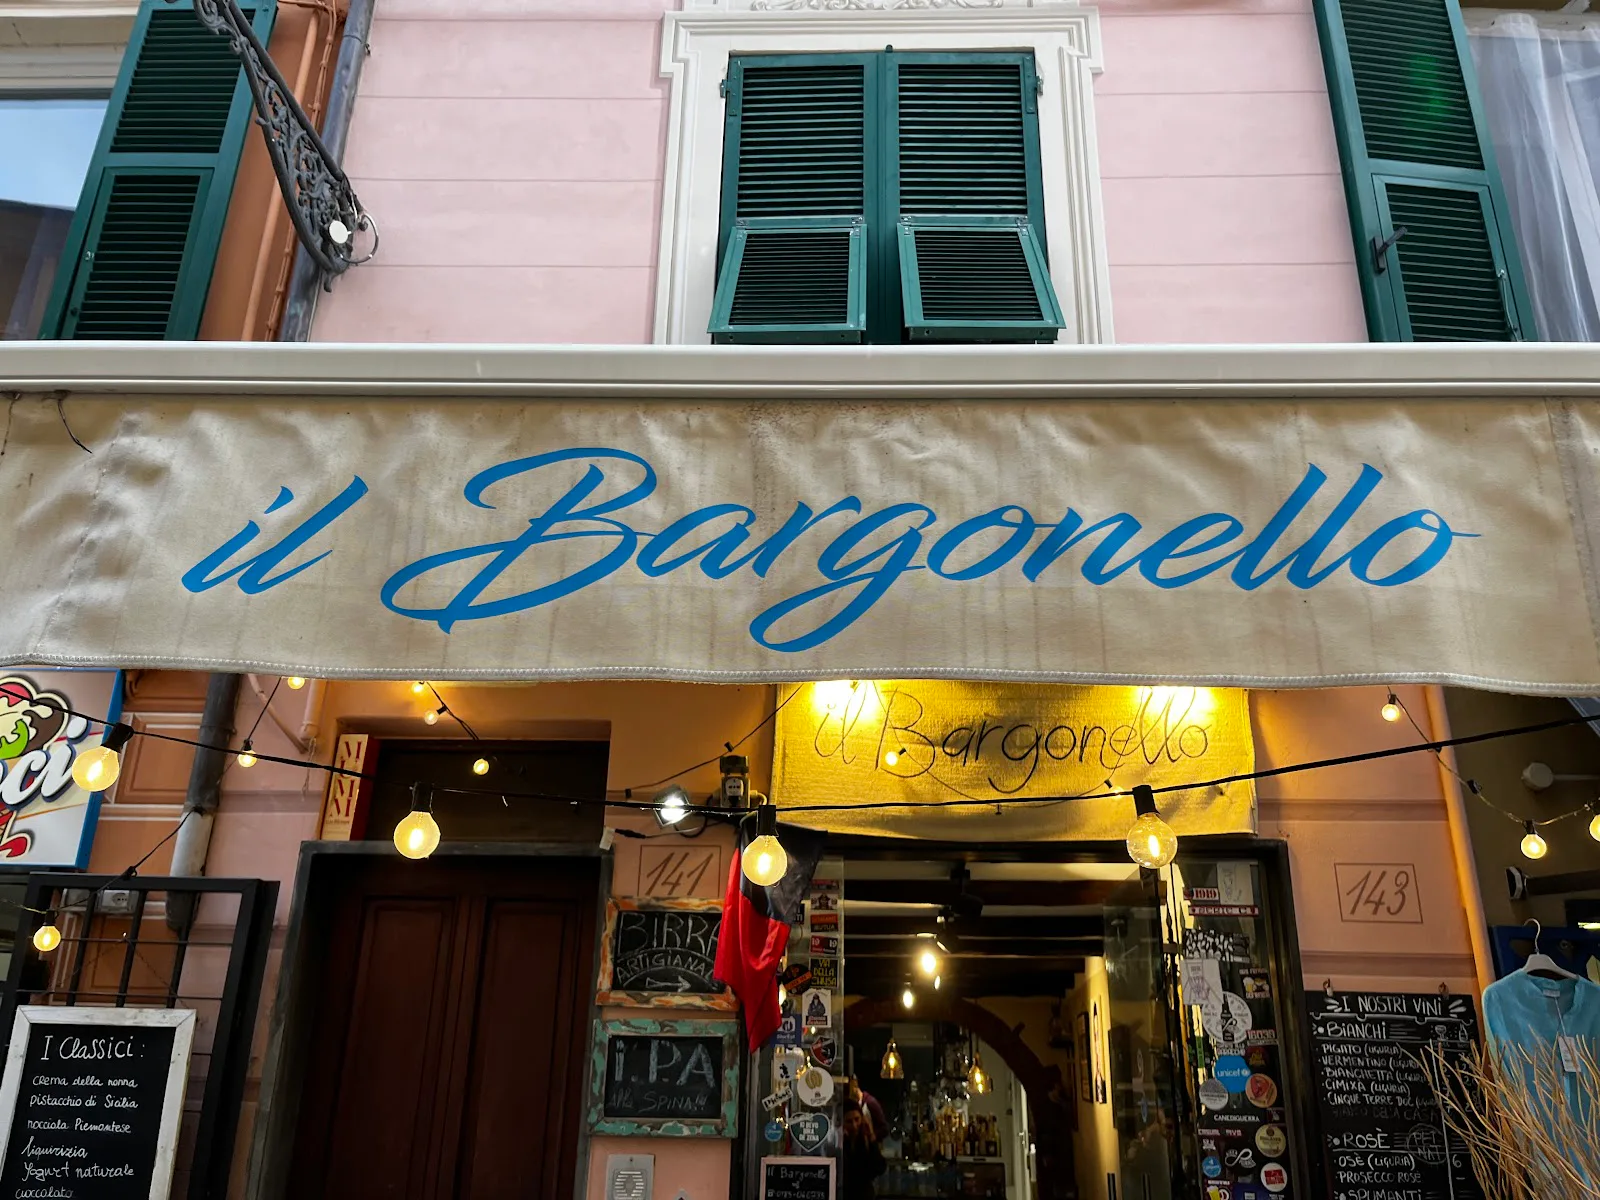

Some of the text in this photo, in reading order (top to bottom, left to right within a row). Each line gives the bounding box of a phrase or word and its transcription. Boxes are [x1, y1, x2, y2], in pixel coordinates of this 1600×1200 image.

[180, 446, 1482, 652] il Bargonello
[875, 686, 1213, 794] Bargonello
[0, 707, 89, 806] ci
[645, 851, 714, 896] 141
[1345, 870, 1410, 916] 143
[813, 967, 834, 977] DELLA
[1341, 996, 1351, 1012] I
[41, 1035, 53, 1060] I
[1322, 1043, 1362, 1055] PIGATO
[1217, 1067, 1240, 1077] unicef
[72, 1076, 103, 1087] della
[107, 1079, 138, 1088] nonna
[85, 1095, 97, 1106] di
[104, 1093, 138, 1108] Sicilia
[1328, 1091, 1361, 1107] CINQUE
[1363, 1094, 1393, 1105] TERRE
[27, 1118, 131, 1133] nocciola Piemontese
[1452, 1154, 1462, 1168] 6
[22, 1161, 135, 1181] Yogurt naturale
[1337, 1171, 1394, 1184] PROSECCO
